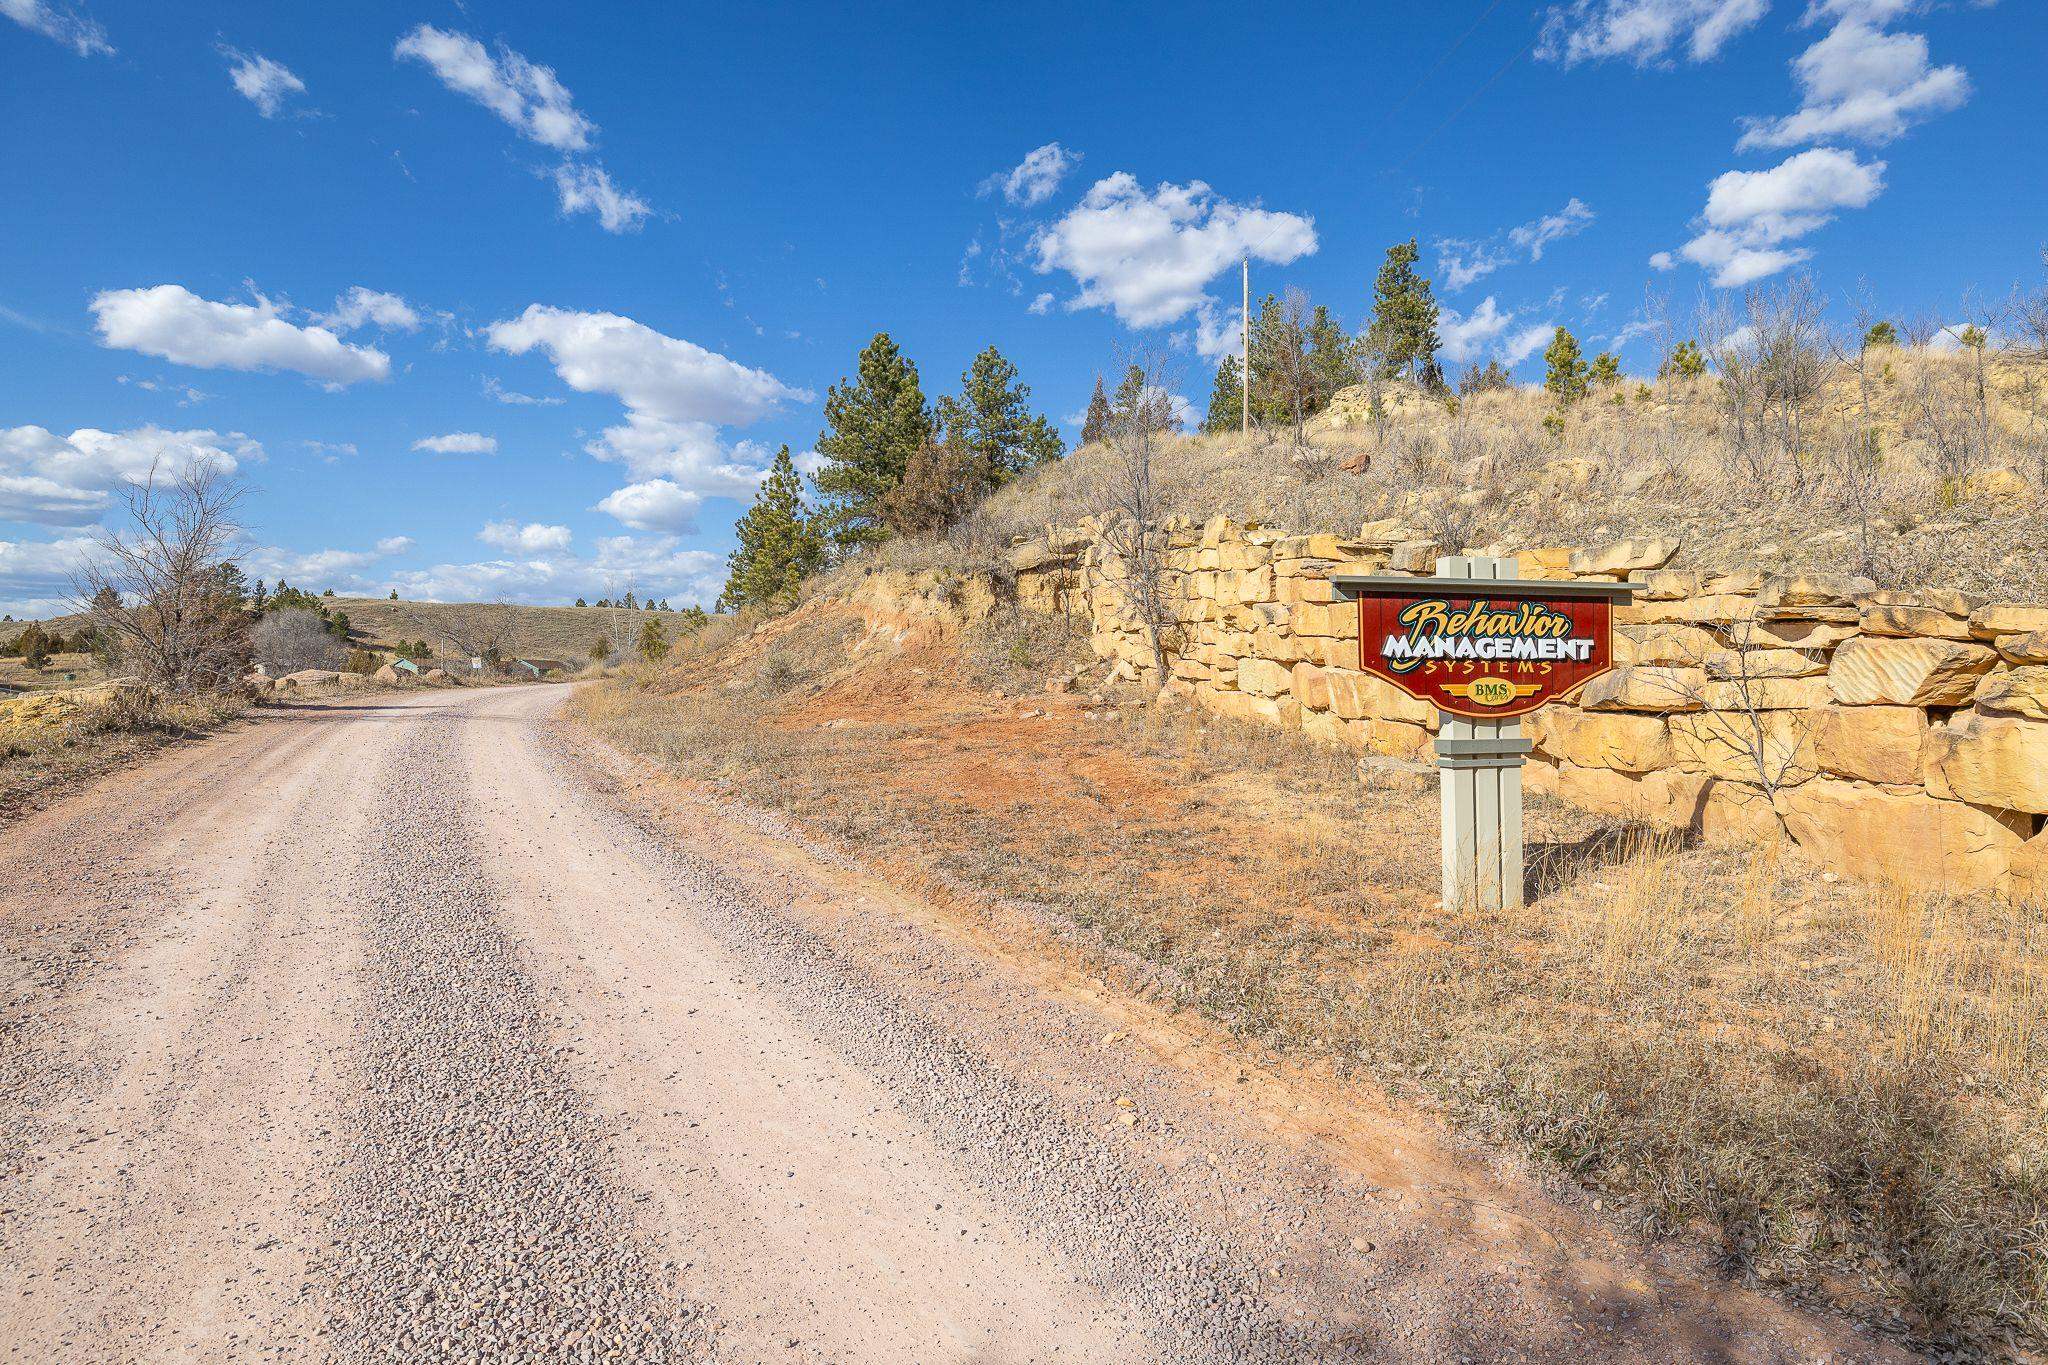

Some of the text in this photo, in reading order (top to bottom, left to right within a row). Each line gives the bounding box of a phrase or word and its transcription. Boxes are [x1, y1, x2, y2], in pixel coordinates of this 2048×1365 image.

[1399, 599, 1571, 643] Behavior
[1382, 635, 1595, 660] MANAGEMENT
[1424, 660, 1553, 675] SYSTEMS
[1475, 684, 1508, 696] BMS
